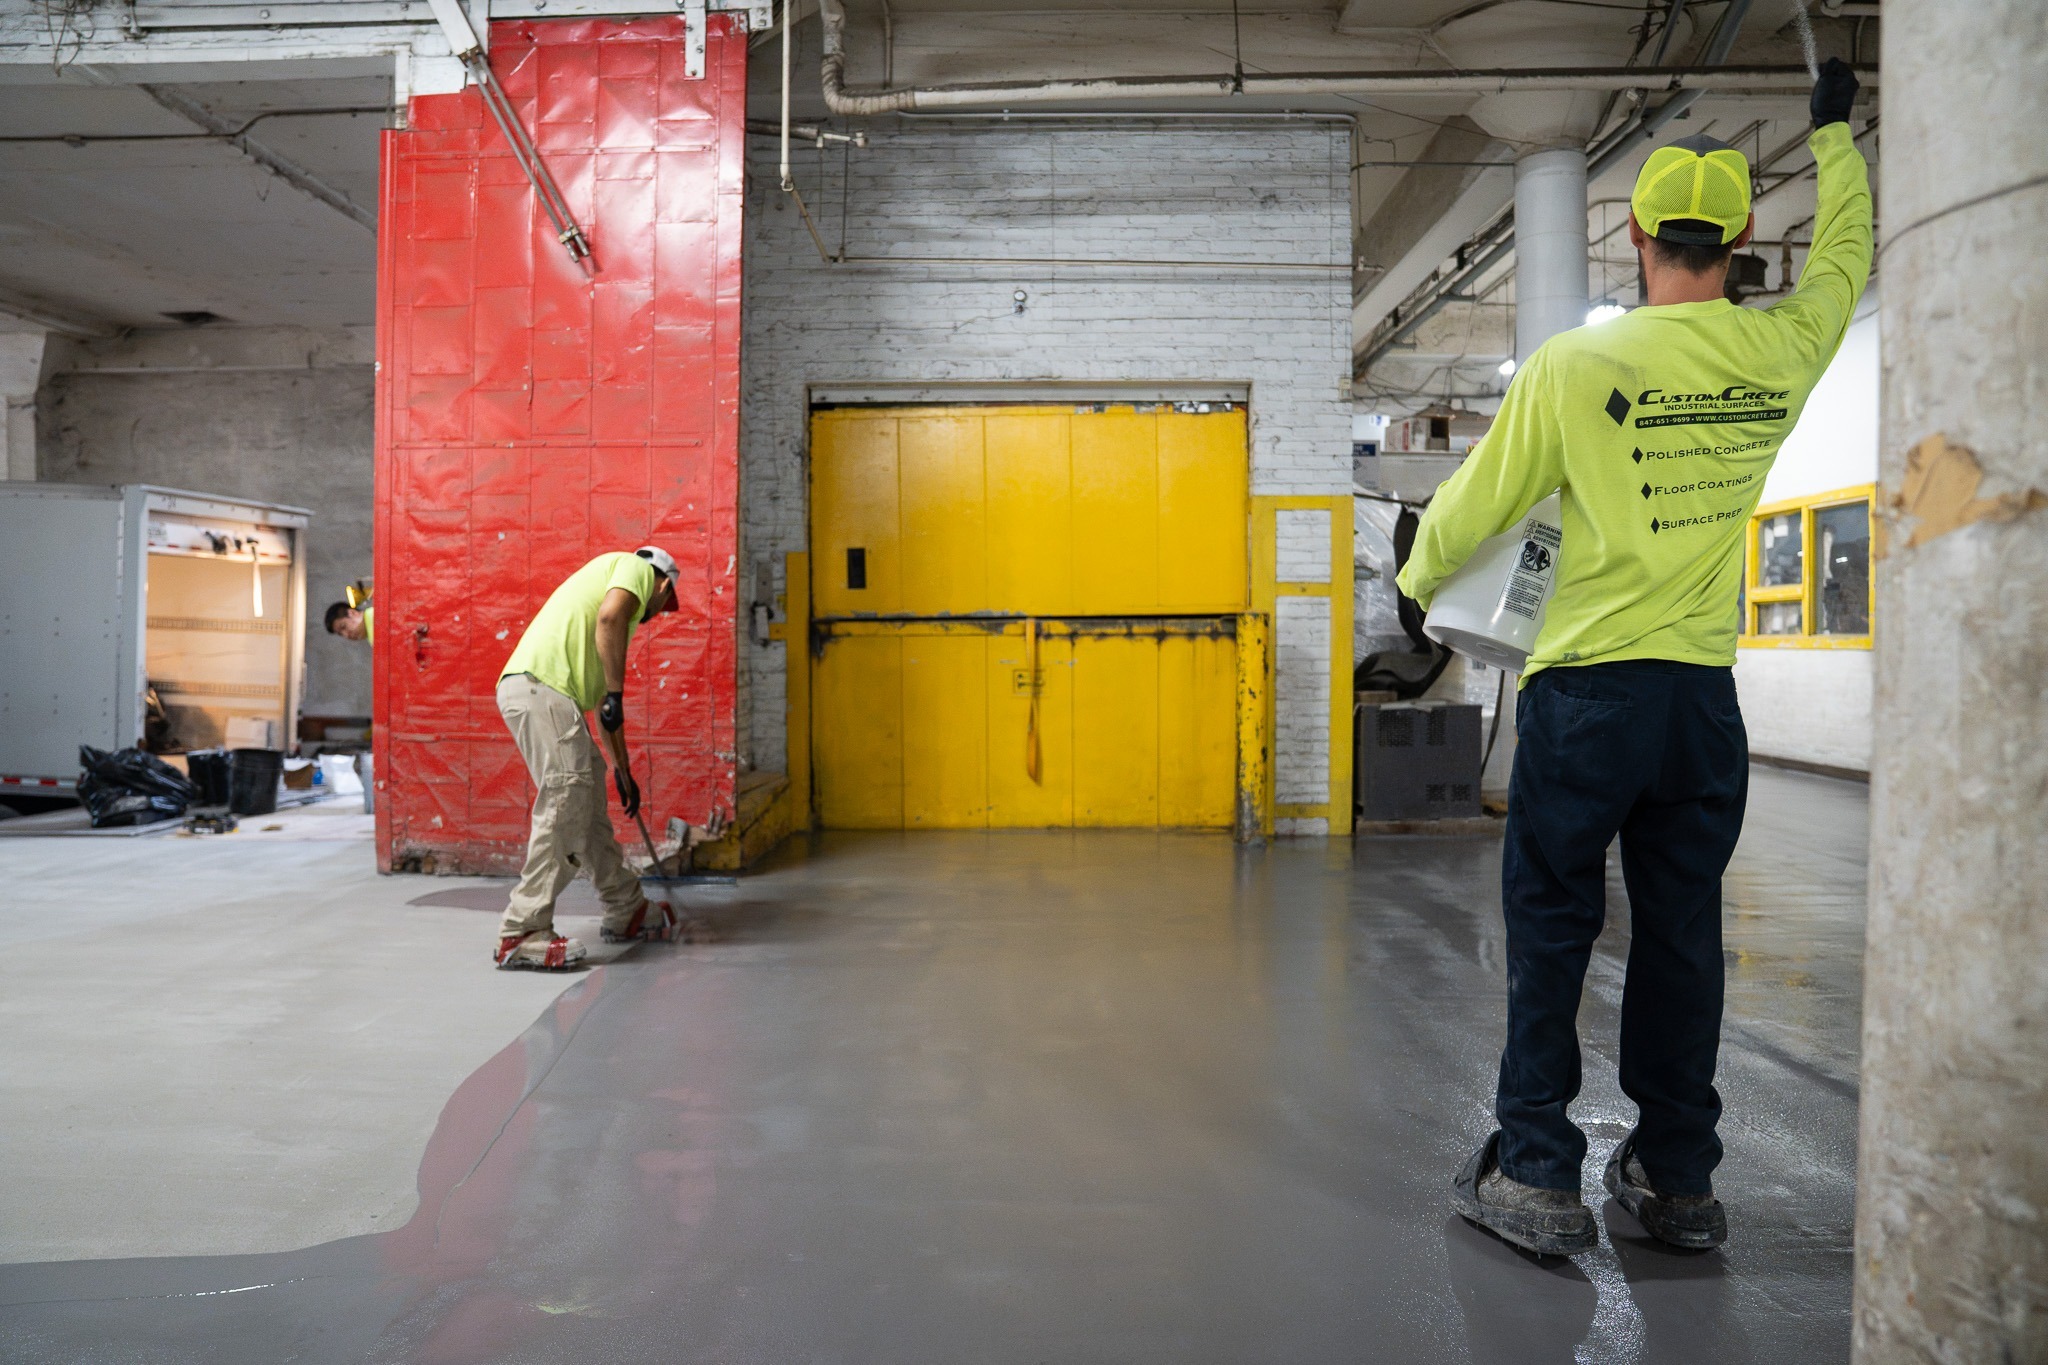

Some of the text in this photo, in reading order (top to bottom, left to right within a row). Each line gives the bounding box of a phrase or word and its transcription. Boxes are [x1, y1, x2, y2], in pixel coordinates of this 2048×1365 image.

[1637, 385, 1790, 406] CUSTOMCRETE
[1664, 400, 1766, 411] INDUSTRIAL SURFACES
[1639, 411, 1785, 427] 847-651-9699 WWW.CUSTOMCRETE.NET
[1646, 439, 1771, 460] POLISHED CONCRETE
[1654, 473, 1753, 496] FLOOR COATINGS
[1661, 507, 1742, 530] SURFACE PREP
